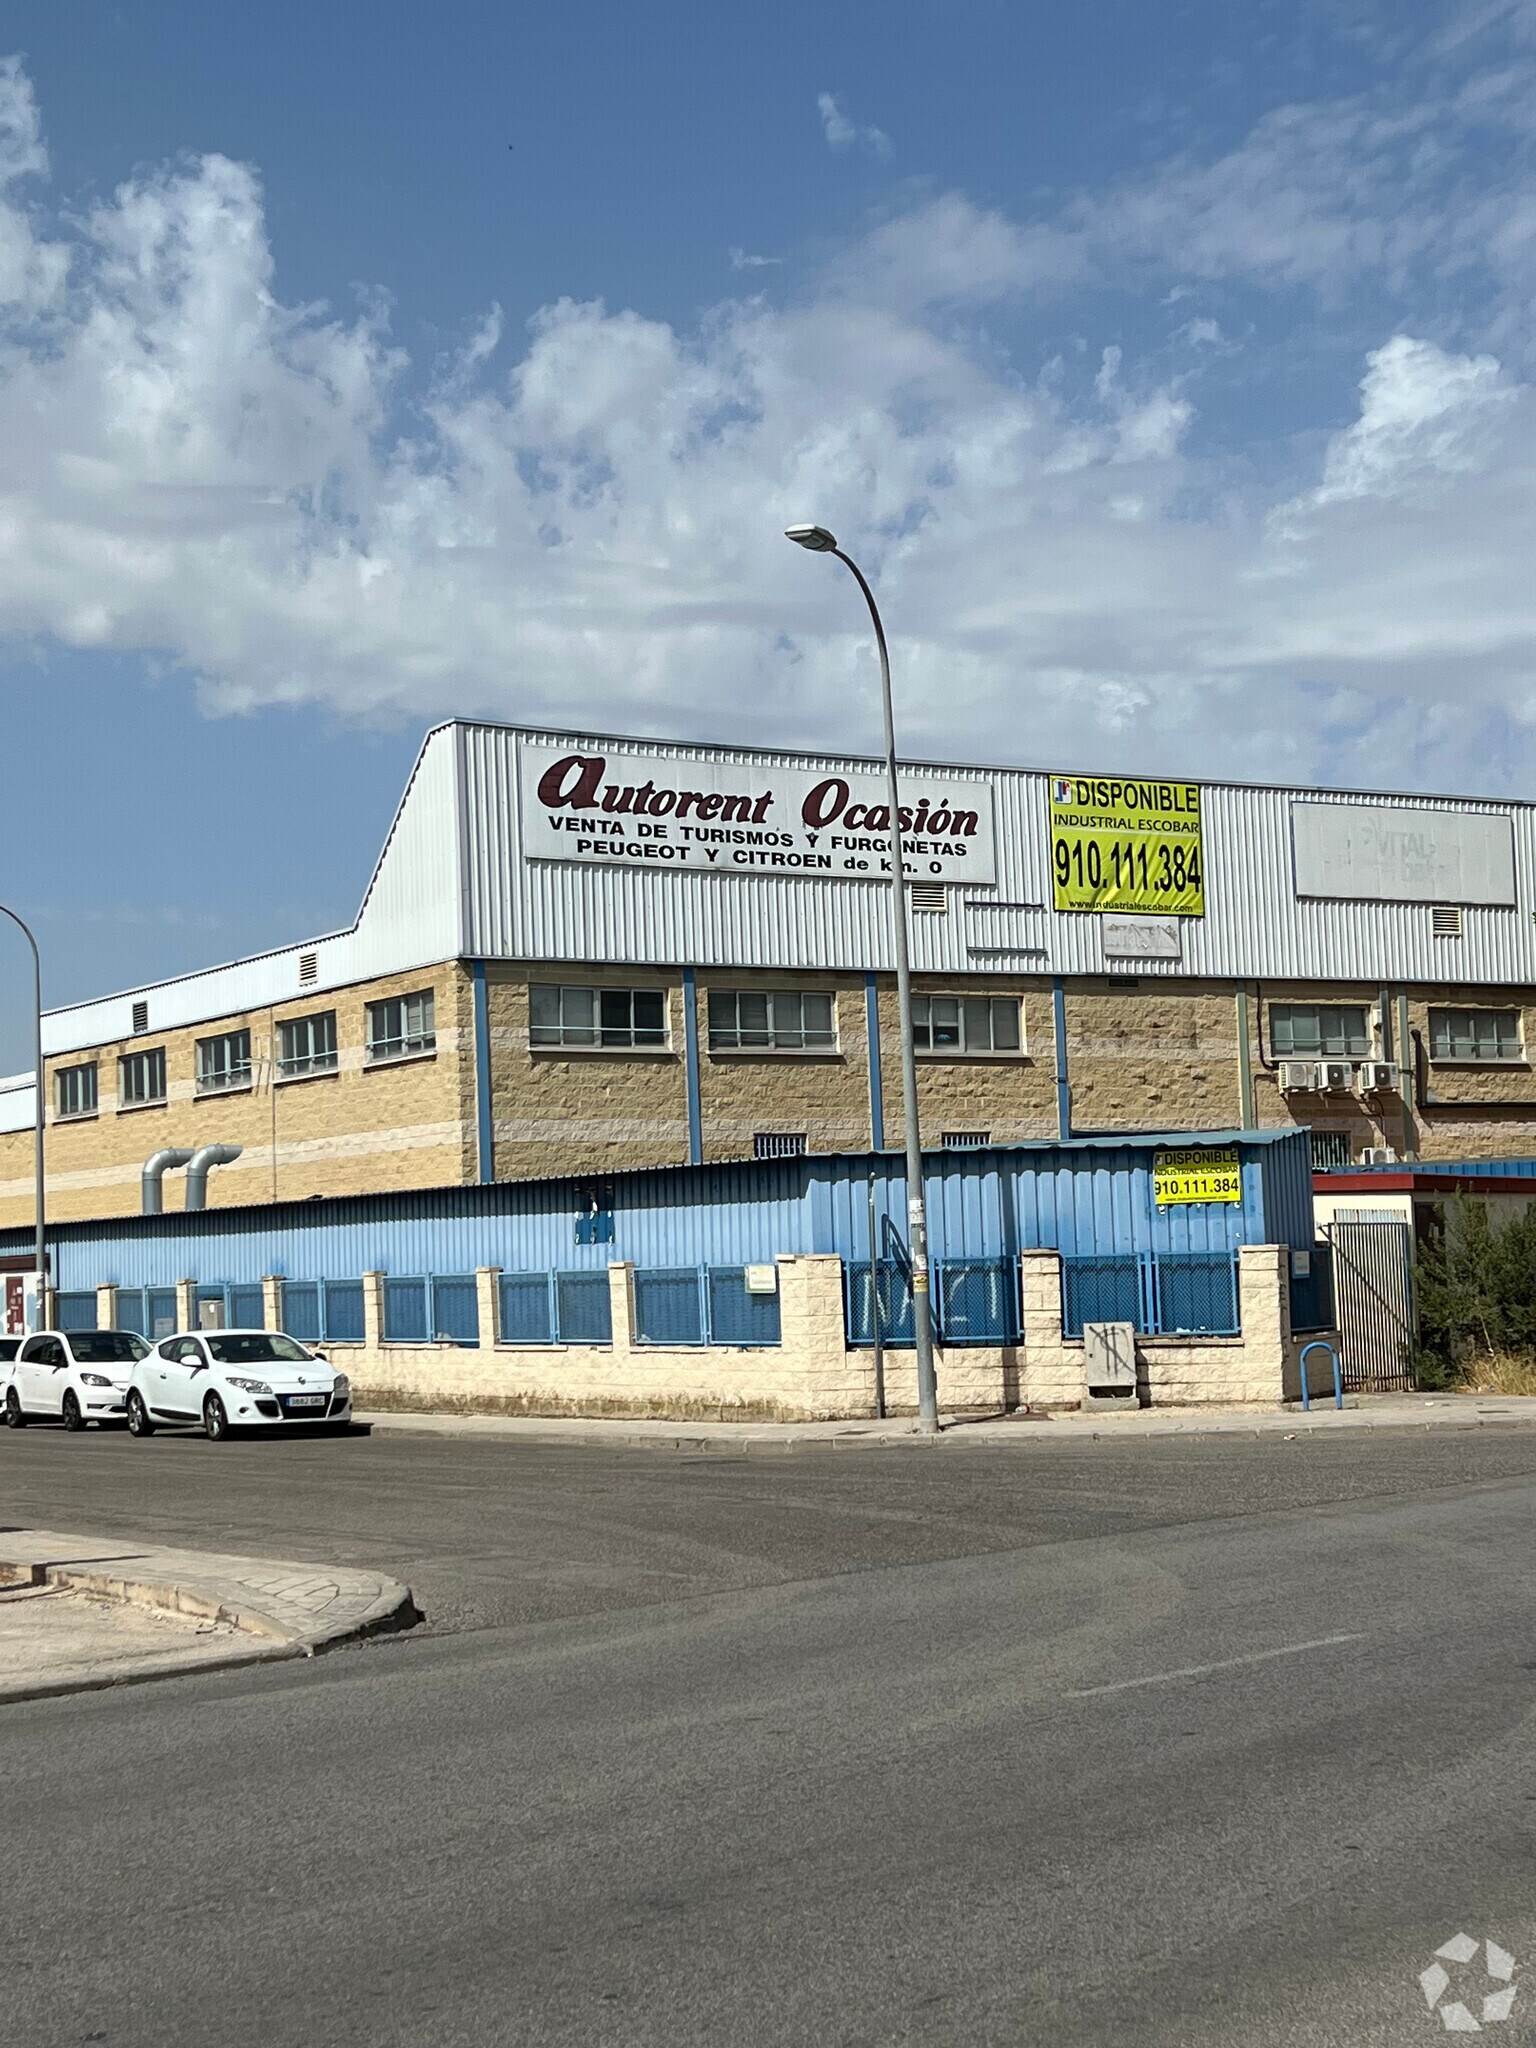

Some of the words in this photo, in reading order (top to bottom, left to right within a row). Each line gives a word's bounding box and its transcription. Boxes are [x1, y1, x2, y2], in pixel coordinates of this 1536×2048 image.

[801, 778, 979, 837] Ocasión
[1076, 779, 1198, 813] DISPONIBLE
[548, 816, 625, 836] VENTA
[637, 823, 668, 839] DE
[680, 826, 794, 847] TURISMOS
[805, 834, 820, 849] Y
[1054, 813, 1135, 830] INDUSTRIAL
[1138, 819, 1199, 834] ESCOBAR
[577, 839, 691, 860] PEUGEOT
[704, 849, 720, 863] Y
[733, 850, 832, 869] CITROEN
[843, 857, 869, 871] de
[1055, 838, 1201, 893] 910.111.384
[1154, 1167, 1199, 1176] NDUSTRIAL
[1165, 1151, 1238, 1165] DISPONIBLE
[1154, 1178, 1238, 1195] 910.111.384
